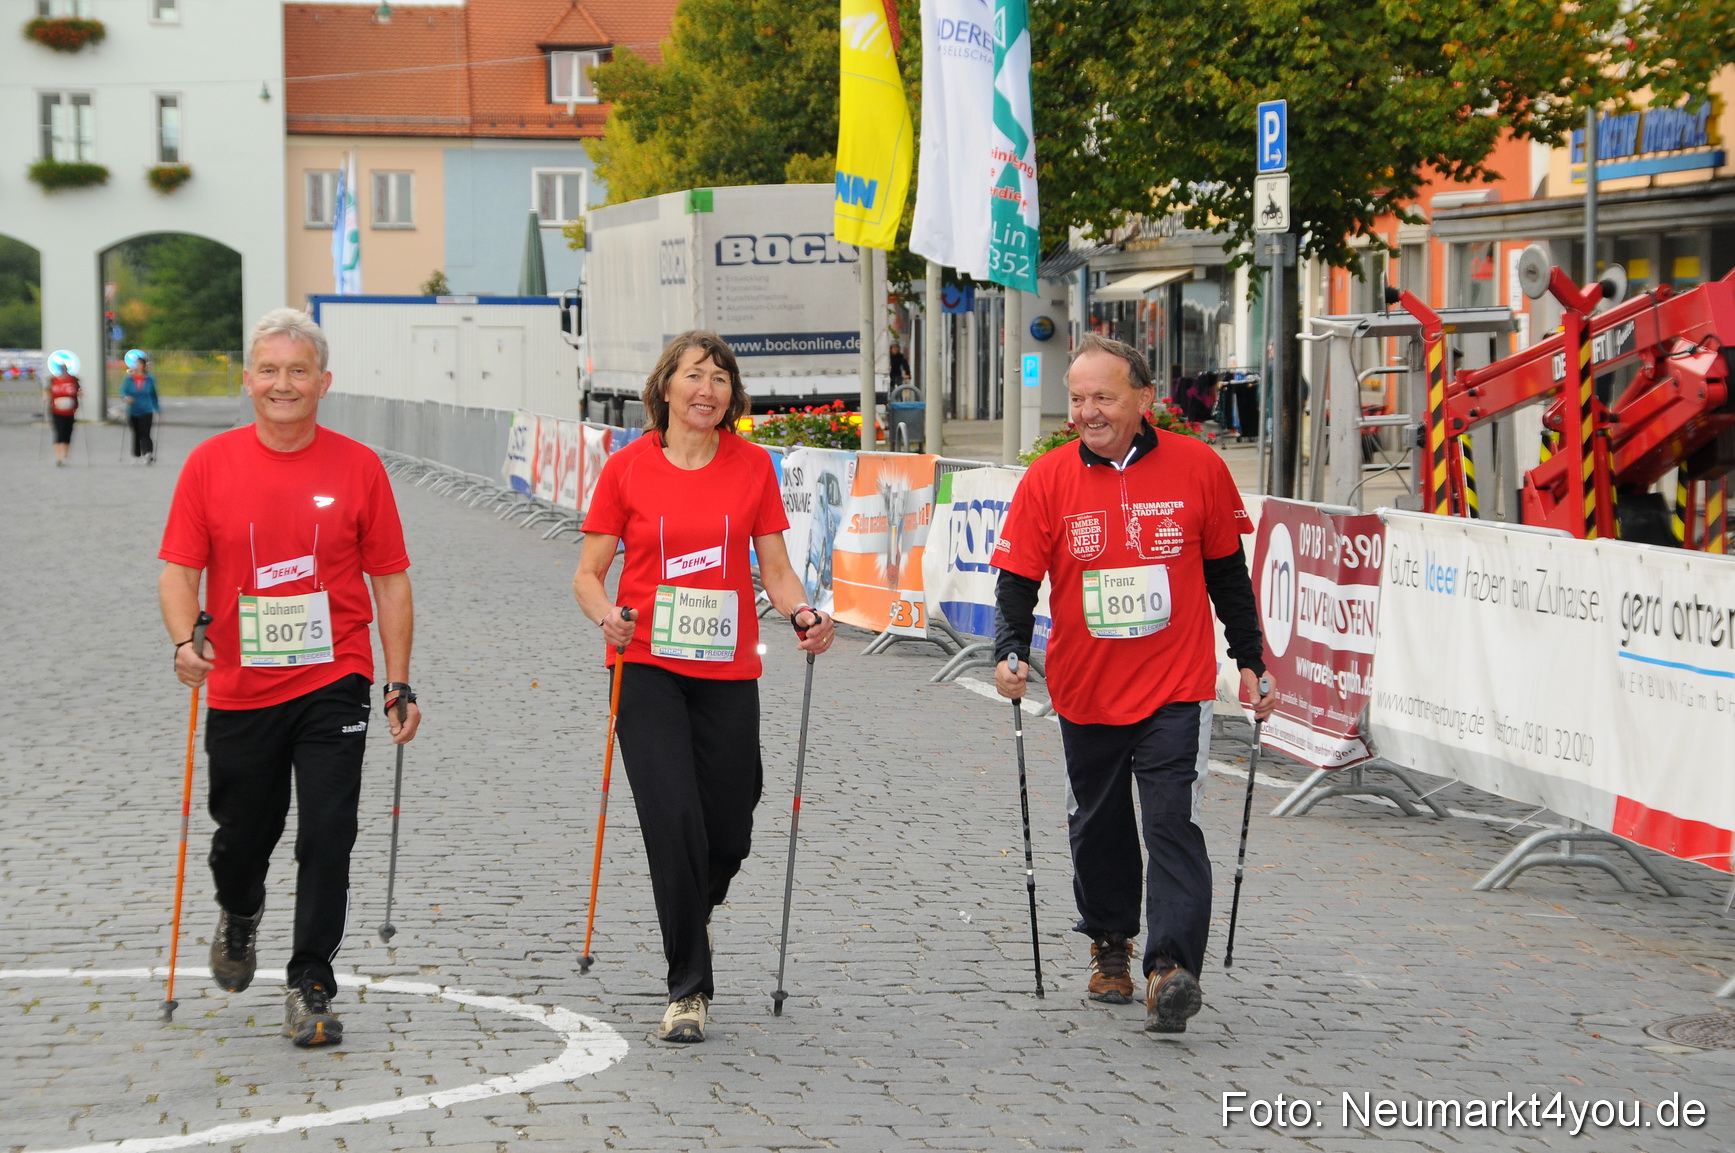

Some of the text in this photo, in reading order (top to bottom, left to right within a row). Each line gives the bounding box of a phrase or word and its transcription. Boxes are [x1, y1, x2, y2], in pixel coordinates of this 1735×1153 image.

[1263, 110, 1280, 163] P
[1026, 359, 1036, 374] P
[1131, 508, 1175, 517] STADTLAUF
[1132, 501, 1184, 510] NEUMARKTER
[1070, 525, 1102, 537] WIEDER
[1071, 518, 1100, 529] IMMER
[1072, 533, 1100, 547] NEU
[1073, 544, 1101, 554] MARKT
[682, 555, 707, 570] DEHN
[272, 564, 298, 579] DEHN
[1103, 574, 1136, 588] Franz
[1389, 543, 1419, 588] Gute
[1464, 555, 1507, 605] haben
[1512, 565, 1530, 611] ein
[1535, 567, 1605, 623] Zuhause.
[679, 592, 717, 609] Monika
[1107, 592, 1163, 615] 8010
[262, 602, 305, 616] Johann
[1621, 579, 1735, 650] gerd ortner
[265, 619, 323, 643] 8075
[678, 615, 732, 637] 8086
